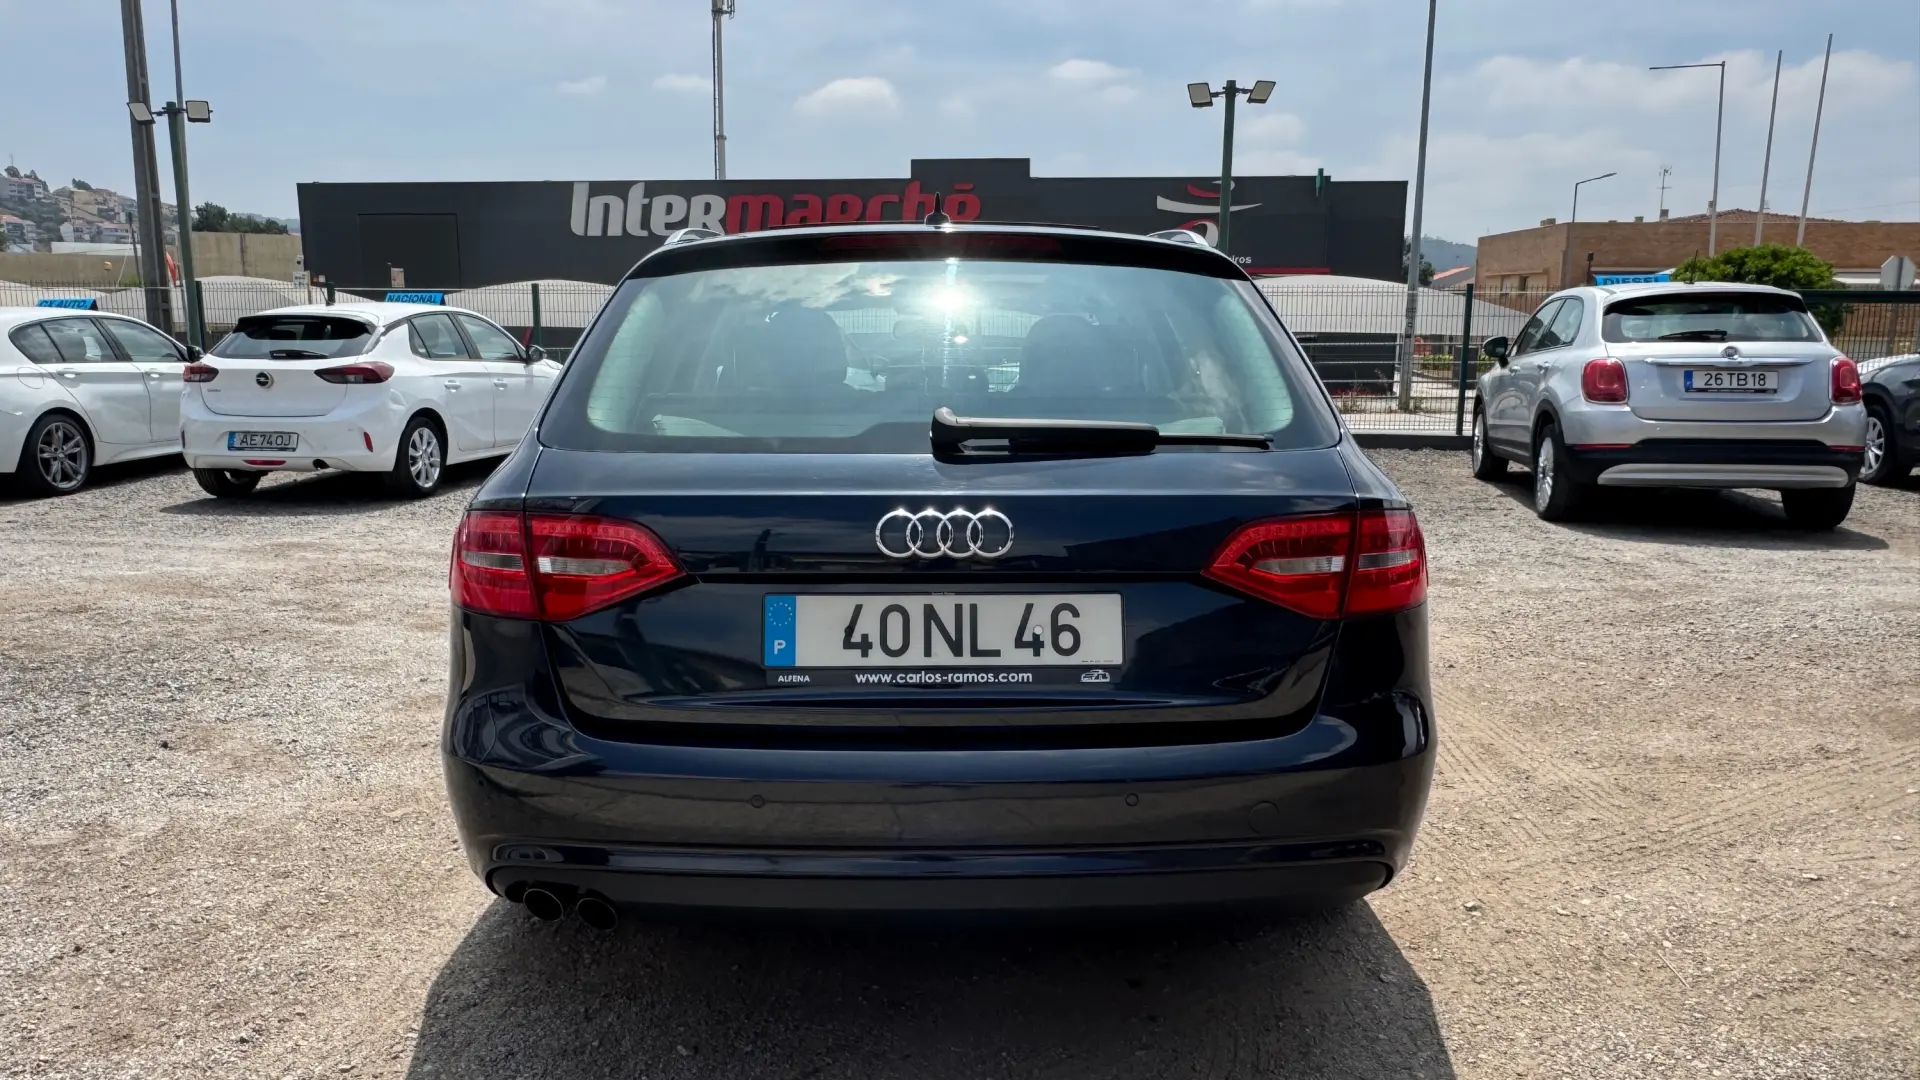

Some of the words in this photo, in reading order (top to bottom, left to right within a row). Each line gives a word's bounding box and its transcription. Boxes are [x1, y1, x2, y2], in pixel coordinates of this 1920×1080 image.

[386, 294, 437, 304] NACIONAL
[1704, 373, 1723, 386] 26
[1727, 373, 1748, 386] TB
[1751, 373, 1766, 387] 18
[239, 434, 257, 446] AE
[260, 434, 273, 446] 74
[842, 604, 910, 658] 40
[923, 603, 1001, 658] NL
[1014, 603, 1081, 657] 46
[773, 640, 787, 655] P
[777, 674, 810, 683] ALFENA
[855, 670, 1033, 684] www.carlos-ramos.com
